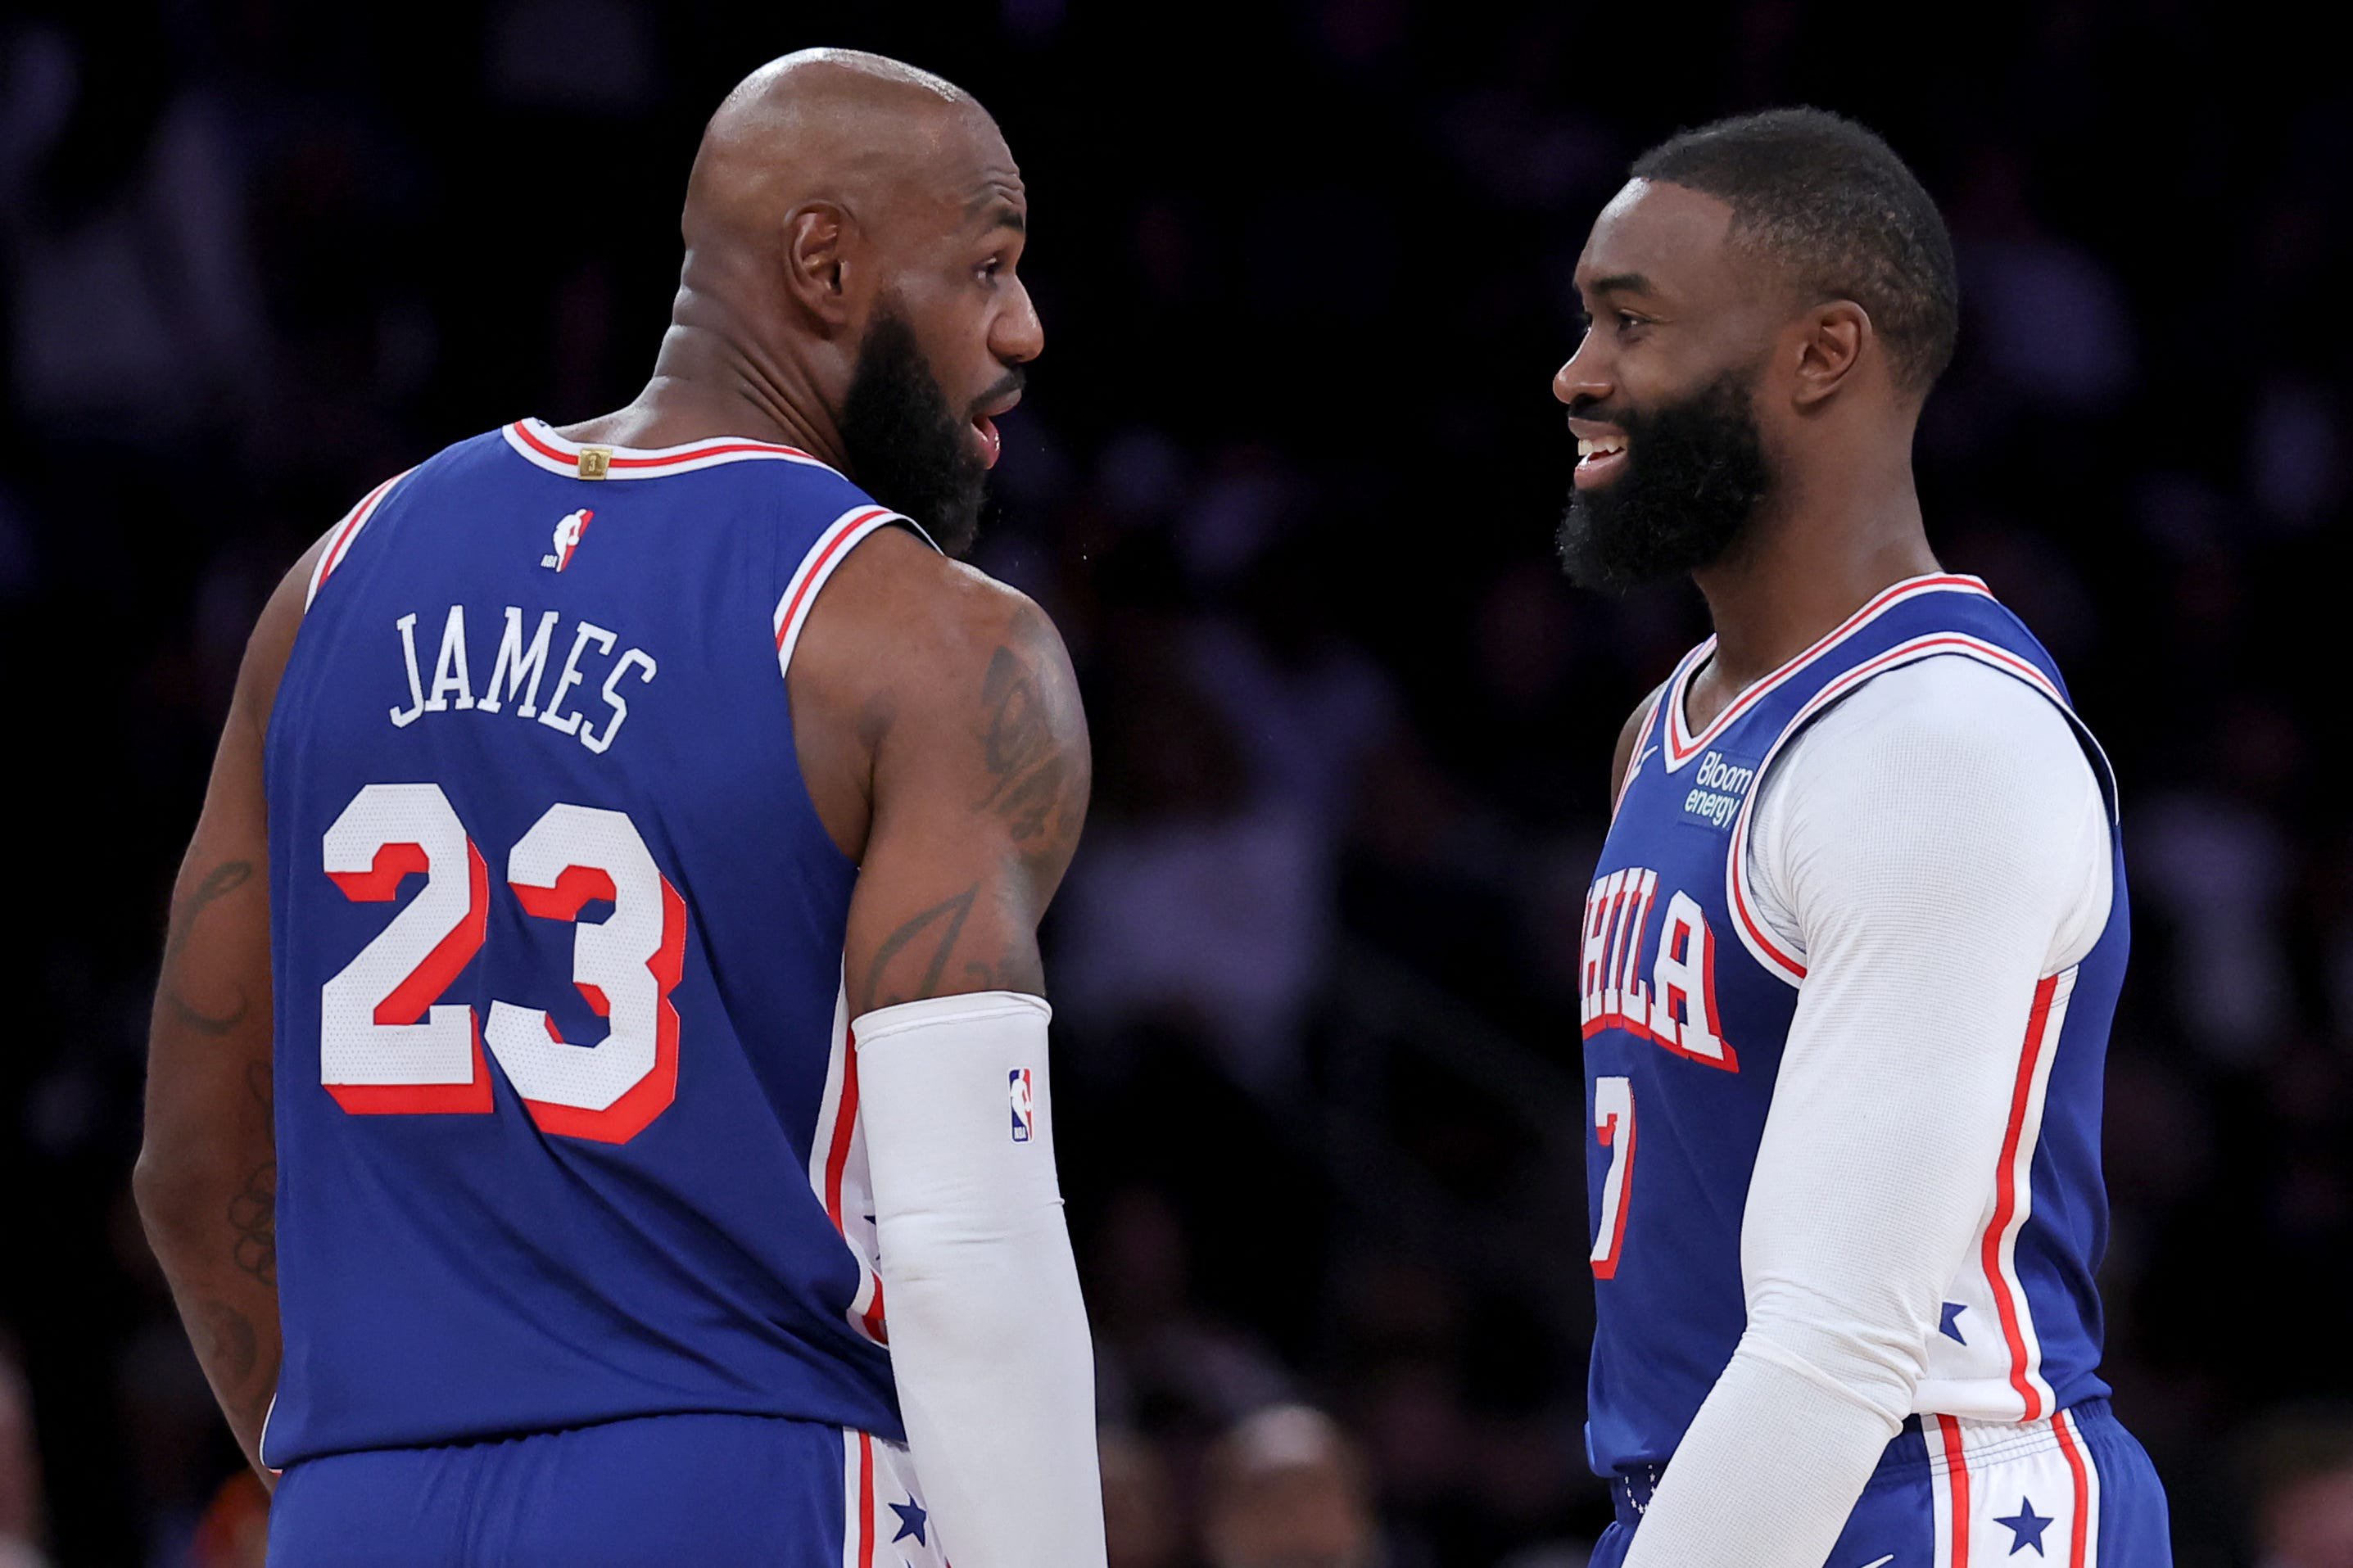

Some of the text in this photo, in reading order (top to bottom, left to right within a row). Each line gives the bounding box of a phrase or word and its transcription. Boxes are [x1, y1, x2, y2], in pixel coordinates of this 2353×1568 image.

[389, 604, 657, 754] JAMES
[1685, 789, 1740, 829] energy
[1696, 751, 1753, 794] Bloom
[320, 783, 686, 1145] 23
[1580, 866, 1740, 1073] HILA
[1590, 1076, 1636, 1281] 7
